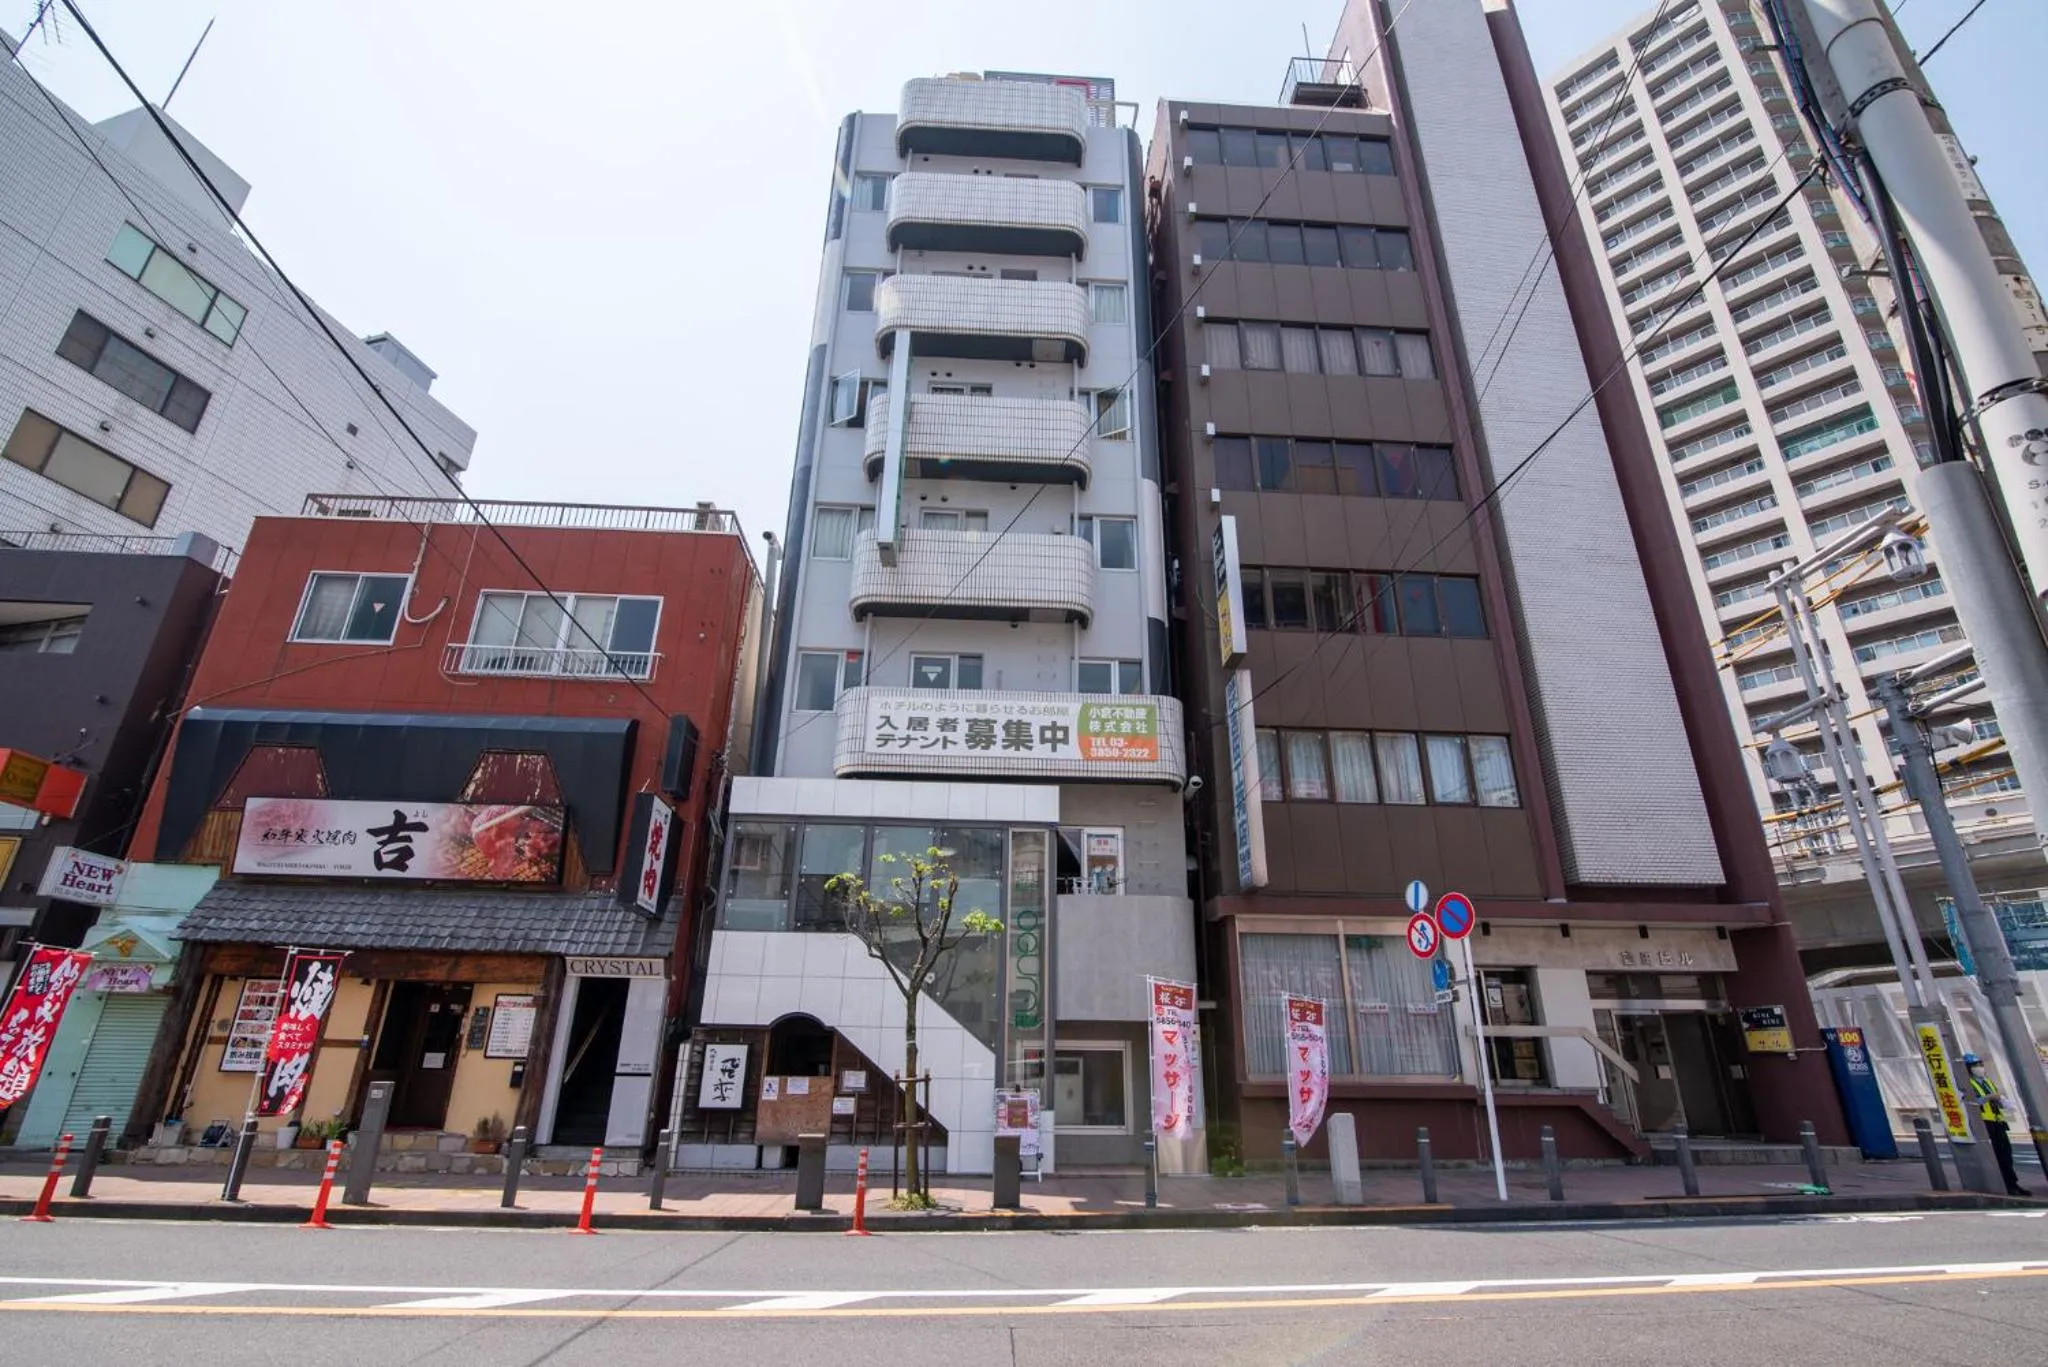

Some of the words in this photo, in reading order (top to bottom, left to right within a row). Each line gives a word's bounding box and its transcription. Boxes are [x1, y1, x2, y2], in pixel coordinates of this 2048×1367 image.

[879, 702, 1070, 717] ホテルのように暮らせるお部屋
[875, 715, 961, 732] 入居者
[964, 718, 1070, 752] 募集中
[1089, 720, 1149, 734] 株式会社
[875, 733, 958, 750] テナント
[366, 809, 430, 872] 吉
[71, 860, 116, 883] NEW
[60, 872, 115, 896] Heart
[102, 966, 130, 977] NEW
[570, 959, 661, 977] CRYSTAL
[107, 976, 142, 987] Heart
[1840, 1031, 1861, 1044] 100
[1162, 1030, 1181, 1131] マッサージ
[1922, 1034, 1964, 1130] 歩行者注意
